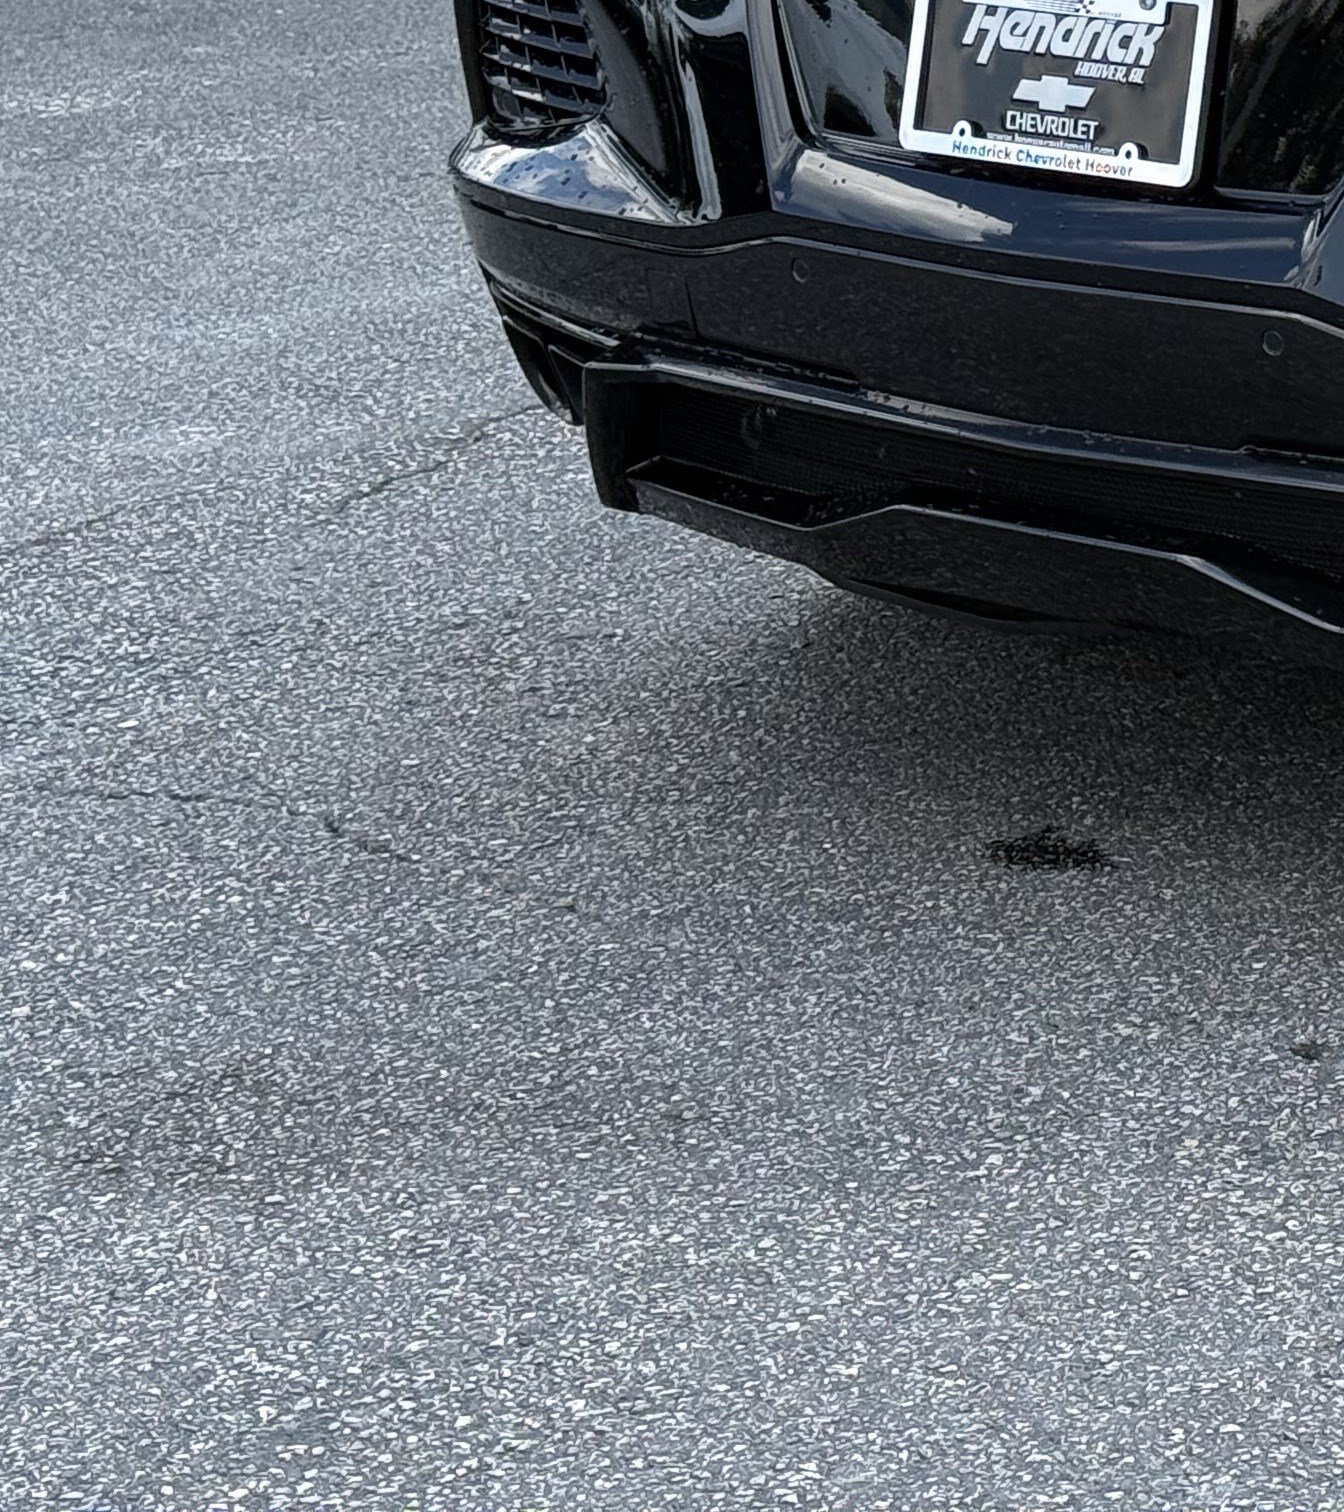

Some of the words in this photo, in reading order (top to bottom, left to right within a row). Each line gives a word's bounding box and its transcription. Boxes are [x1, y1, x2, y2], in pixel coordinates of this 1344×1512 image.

[961, 4, 1166, 65] Hendrick
[1005, 110, 1100, 140] CHEVROLET
[952, 140, 1012, 161] Hendrick
[1016, 149, 1081, 171] Chevrolet
[1085, 159, 1134, 177] Hoover
